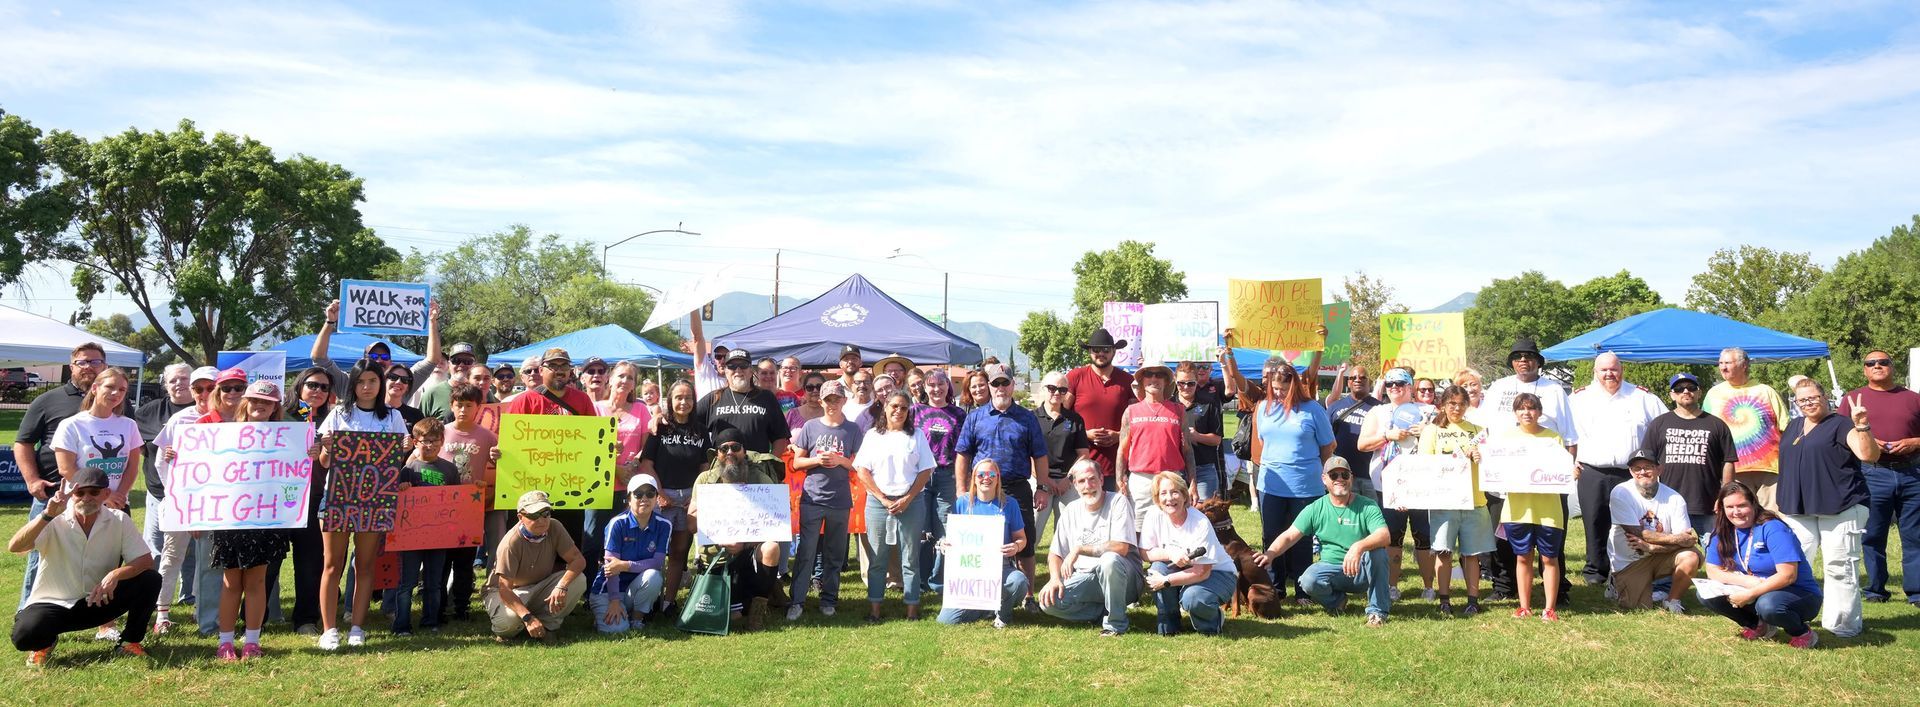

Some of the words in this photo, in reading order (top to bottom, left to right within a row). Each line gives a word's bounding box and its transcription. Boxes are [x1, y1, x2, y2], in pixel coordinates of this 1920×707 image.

[349, 289, 403, 310] WALK
[404, 295, 427, 308] FOR
[1259, 281, 1286, 303] NOT
[1291, 282, 1311, 301] BE
[355, 306, 429, 330] RECOVERY
[1105, 314, 1132, 327] BUT
[1261, 304, 1290, 320] SAD
[1398, 338, 1450, 356] OVER
[716, 404, 741, 416] FREAK
[742, 405, 767, 416] SHOW
[184, 427, 220, 451] SAY
[238, 425, 291, 450] BYE
[512, 419, 587, 445] Stronger
[683, 434, 705, 448] SHOW
[1666, 428, 1711, 438] SUPPORT
[1666, 436, 1685, 444] YOUR
[1686, 437, 1709, 446] LOCAL
[334, 435, 398, 466] SAY
[521, 448, 583, 467] Together
[1665, 443, 1708, 456] NEEDLE
[1665, 455, 1706, 465] EXCHANGE
[178, 461, 211, 488] TO
[223, 458, 312, 483] GETTING
[512, 470, 541, 491] Step
[544, 473, 556, 490] by
[560, 472, 587, 491] Step
[188, 493, 278, 524] HIGH
[958, 529, 984, 546] YOU
[959, 553, 982, 569] ARE
[948, 577, 1001, 601] WORTHY
